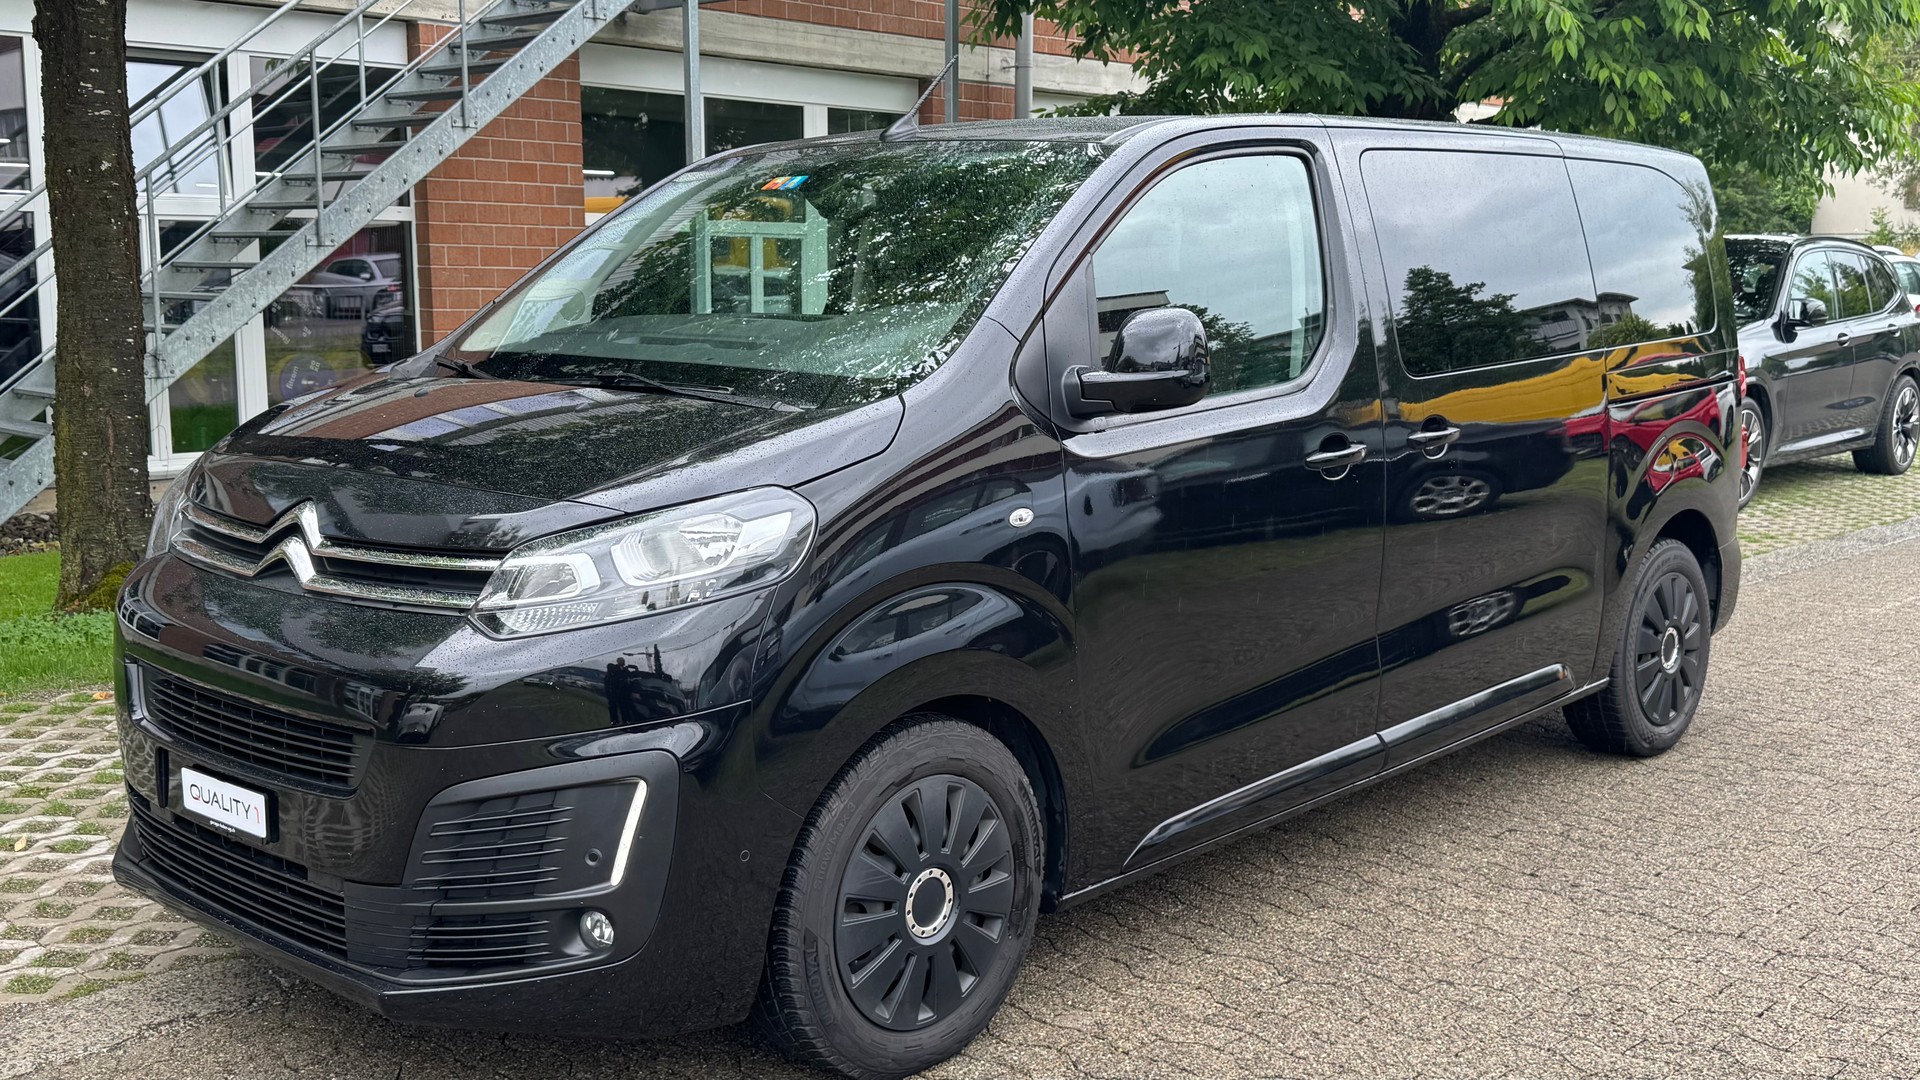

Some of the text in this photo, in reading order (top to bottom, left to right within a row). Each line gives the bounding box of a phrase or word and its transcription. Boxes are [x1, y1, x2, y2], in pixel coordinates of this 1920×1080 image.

[285, 366, 299, 390] fitcom
[189, 783, 260, 825] QUALITY 1
[847, 801, 857, 813] 3
[1021, 786, 1041, 862] UNIROYAL
[805, 940, 835, 1026] UNIROYAL
